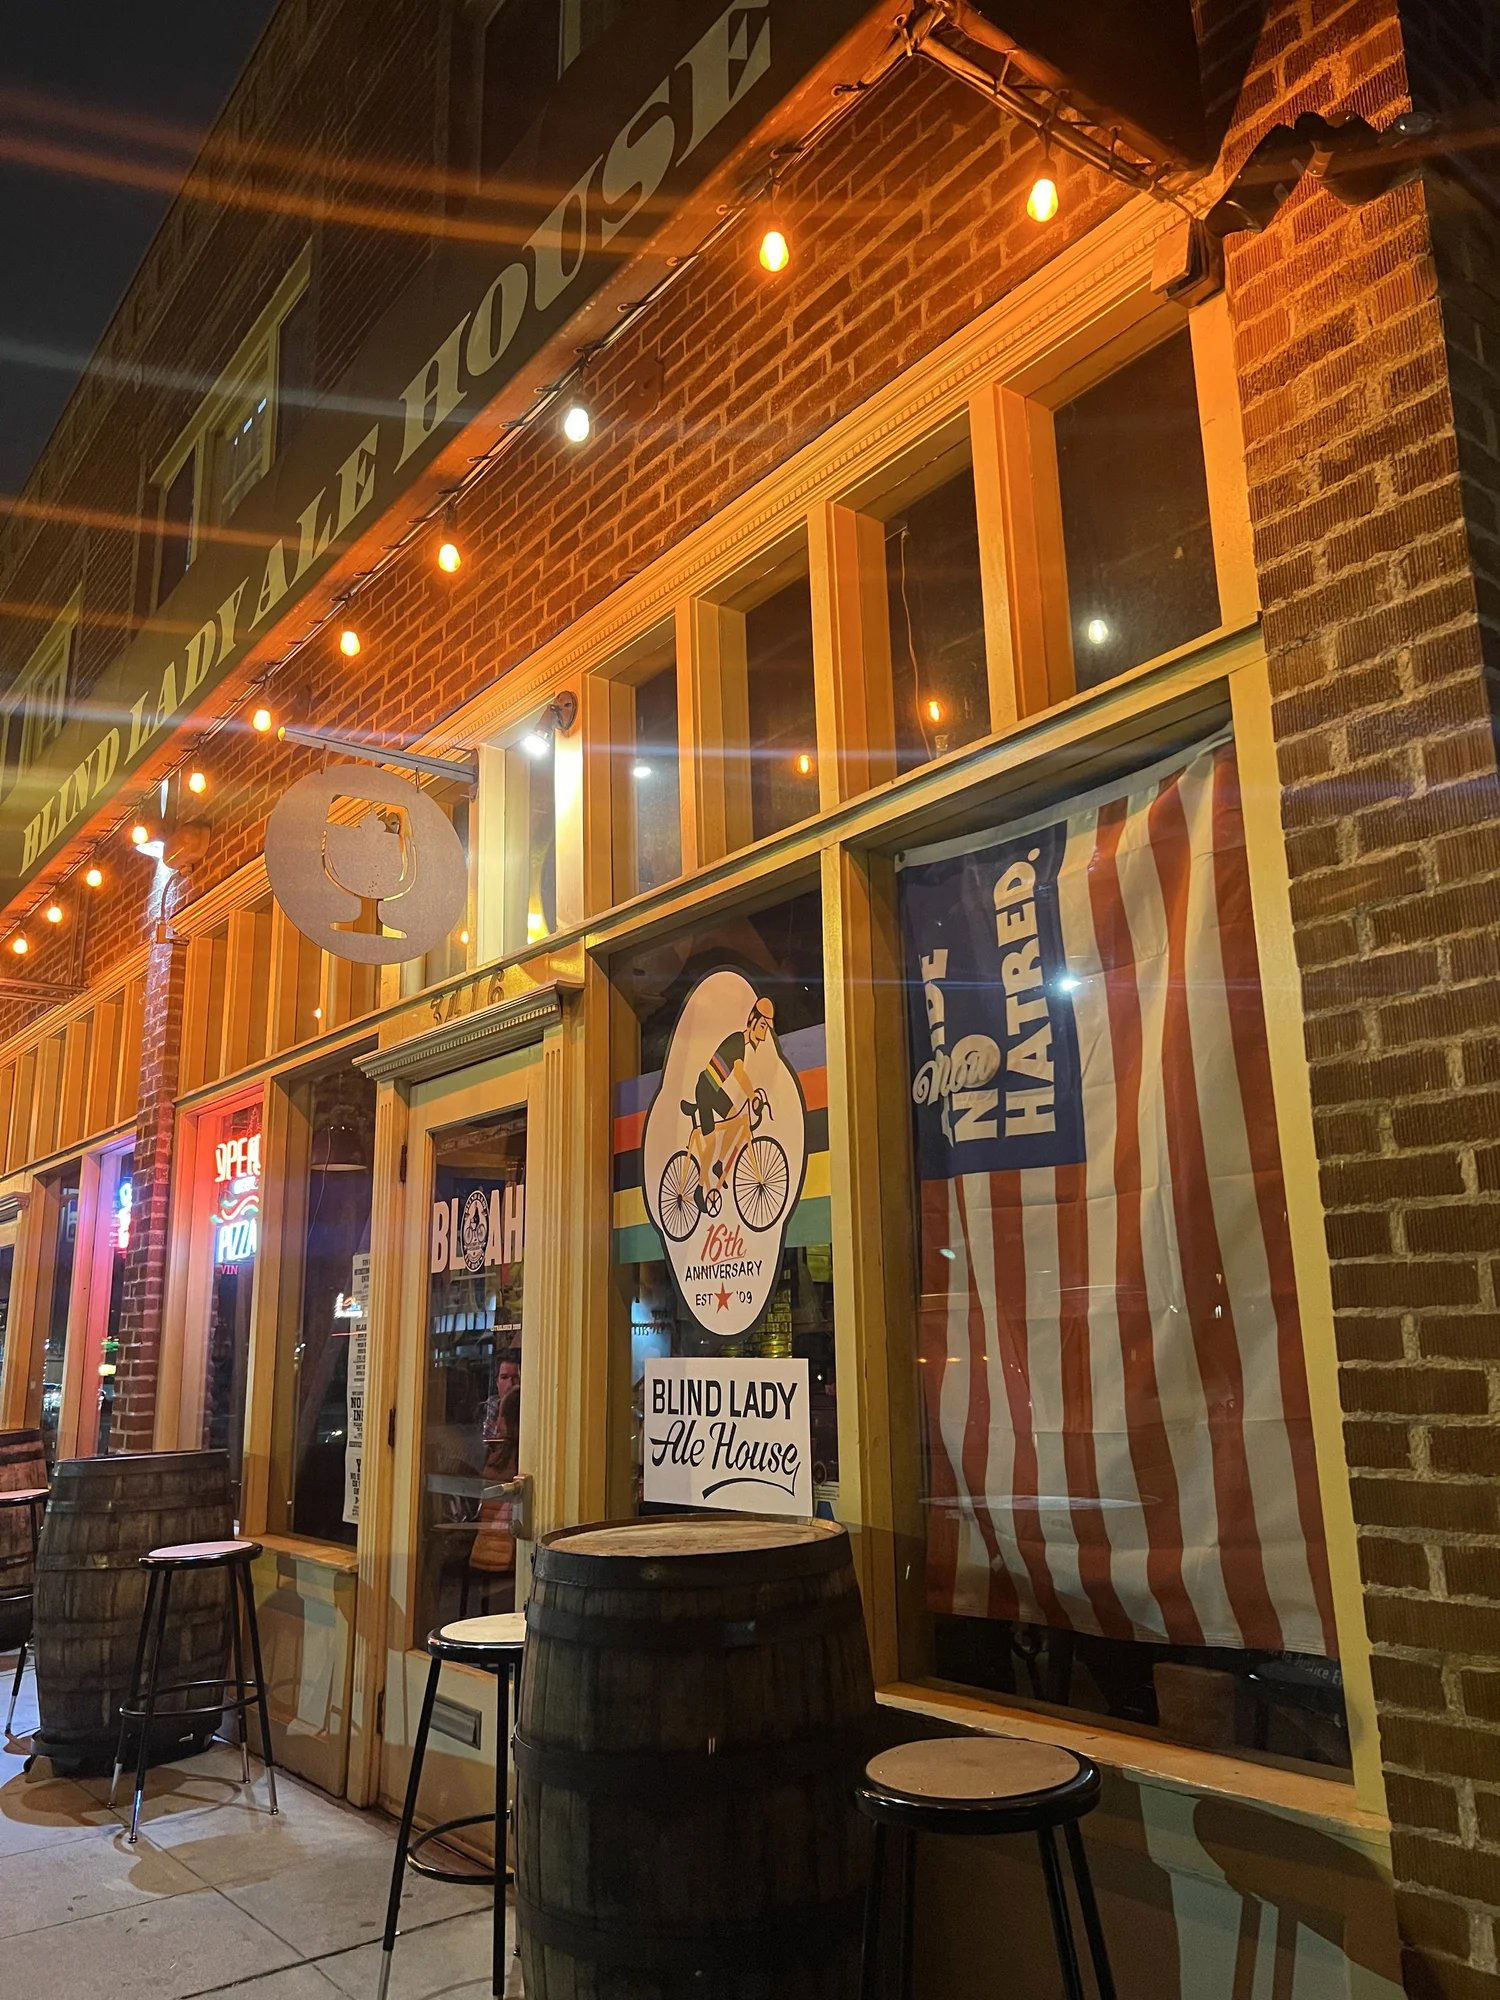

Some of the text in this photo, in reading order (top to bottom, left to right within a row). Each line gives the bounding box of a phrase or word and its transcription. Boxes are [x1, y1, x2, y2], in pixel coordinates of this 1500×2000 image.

[19, 0, 771, 877] BLIND LADY ALE HOUSE
[993, 847, 1056, 1137] HATRED.
[700, 1223, 747, 1262] 16th
[685, 1260, 763, 1282] ANNIVERSARY
[695, 1291, 752, 1307] EST '09
[652, 1378, 798, 1421] BLIND LADY
[649, 1419, 801, 1478] Ale House
